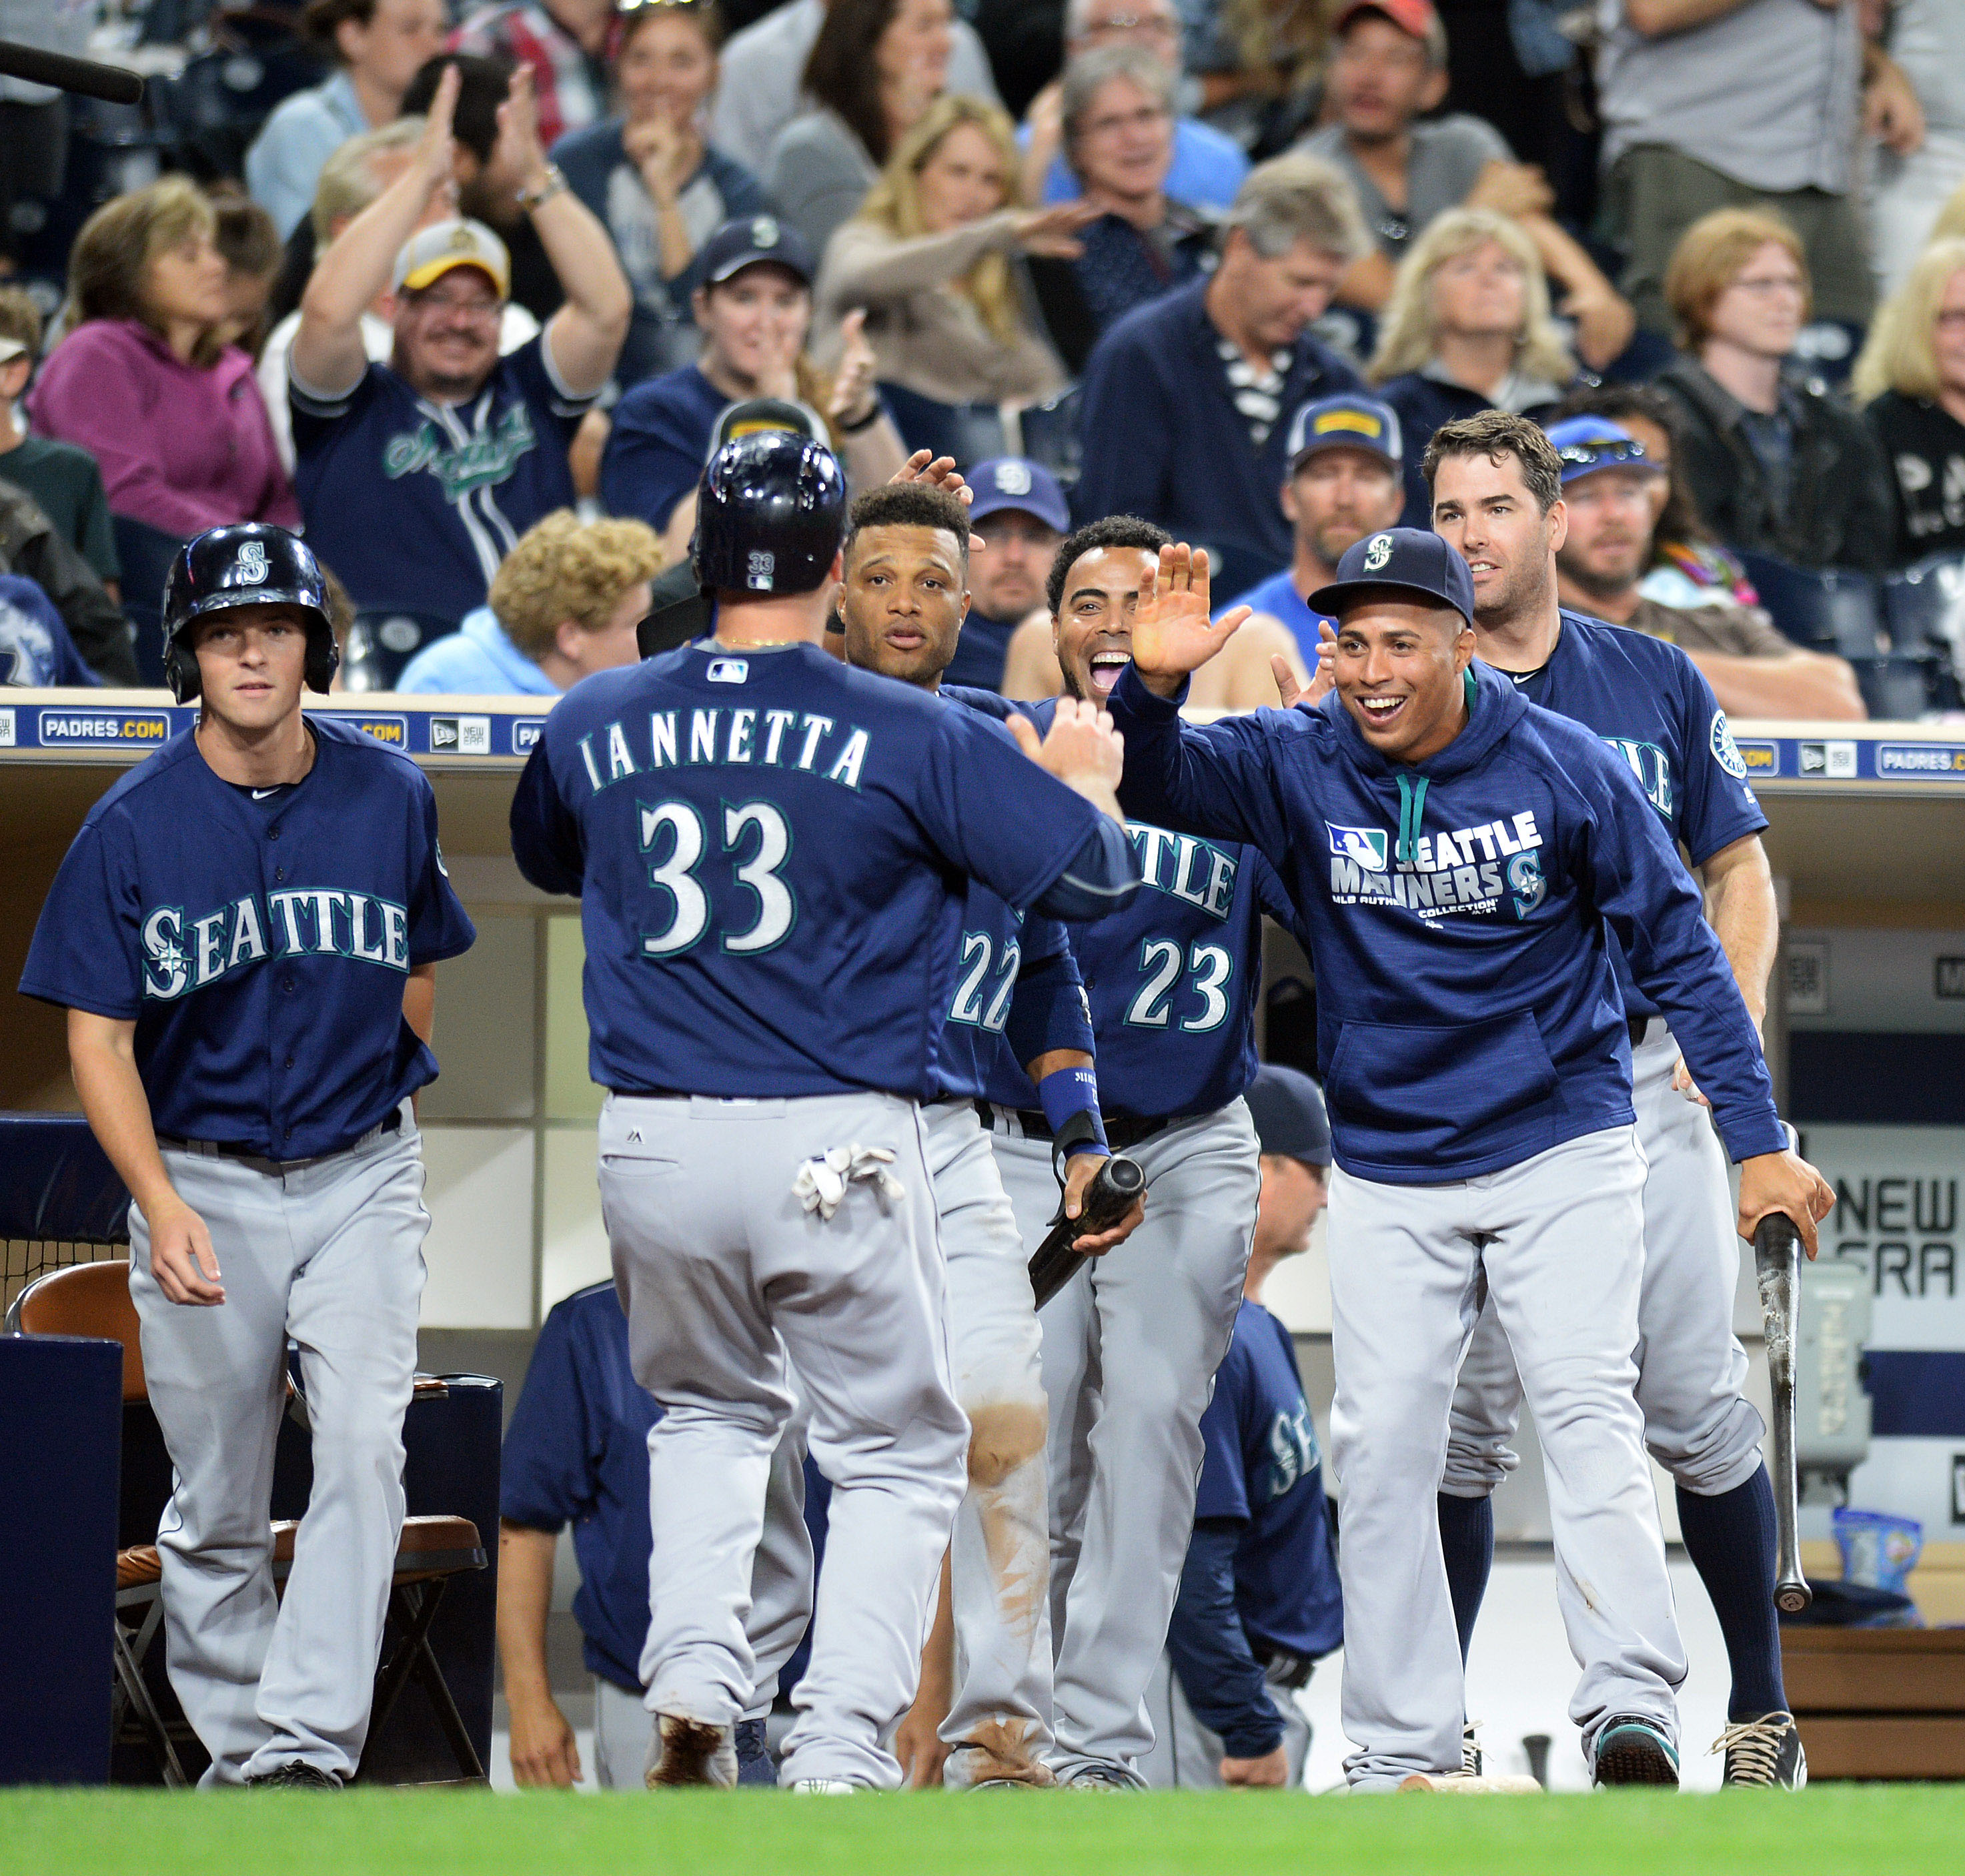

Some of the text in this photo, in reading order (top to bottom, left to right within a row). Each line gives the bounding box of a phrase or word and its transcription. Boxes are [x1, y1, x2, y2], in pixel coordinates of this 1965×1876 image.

[234, 541, 272, 586] S
[748, 551, 774, 574] 33
[1363, 534, 1394, 572] S
[46, 719, 163, 739] PADRES.COM
[464, 727, 484, 736] NEW
[578, 709, 870, 795] IANNETTA
[635, 799, 798, 957] 33
[1333, 895, 1356, 904] MLB
[1418, 898, 1496, 919] COLLECTION
[140, 888, 410, 1001] SEATTLE
[947, 931, 1021, 1033] 22
[1124, 937, 1233, 1033] 23
[1836, 1178, 1956, 1234] NEW
